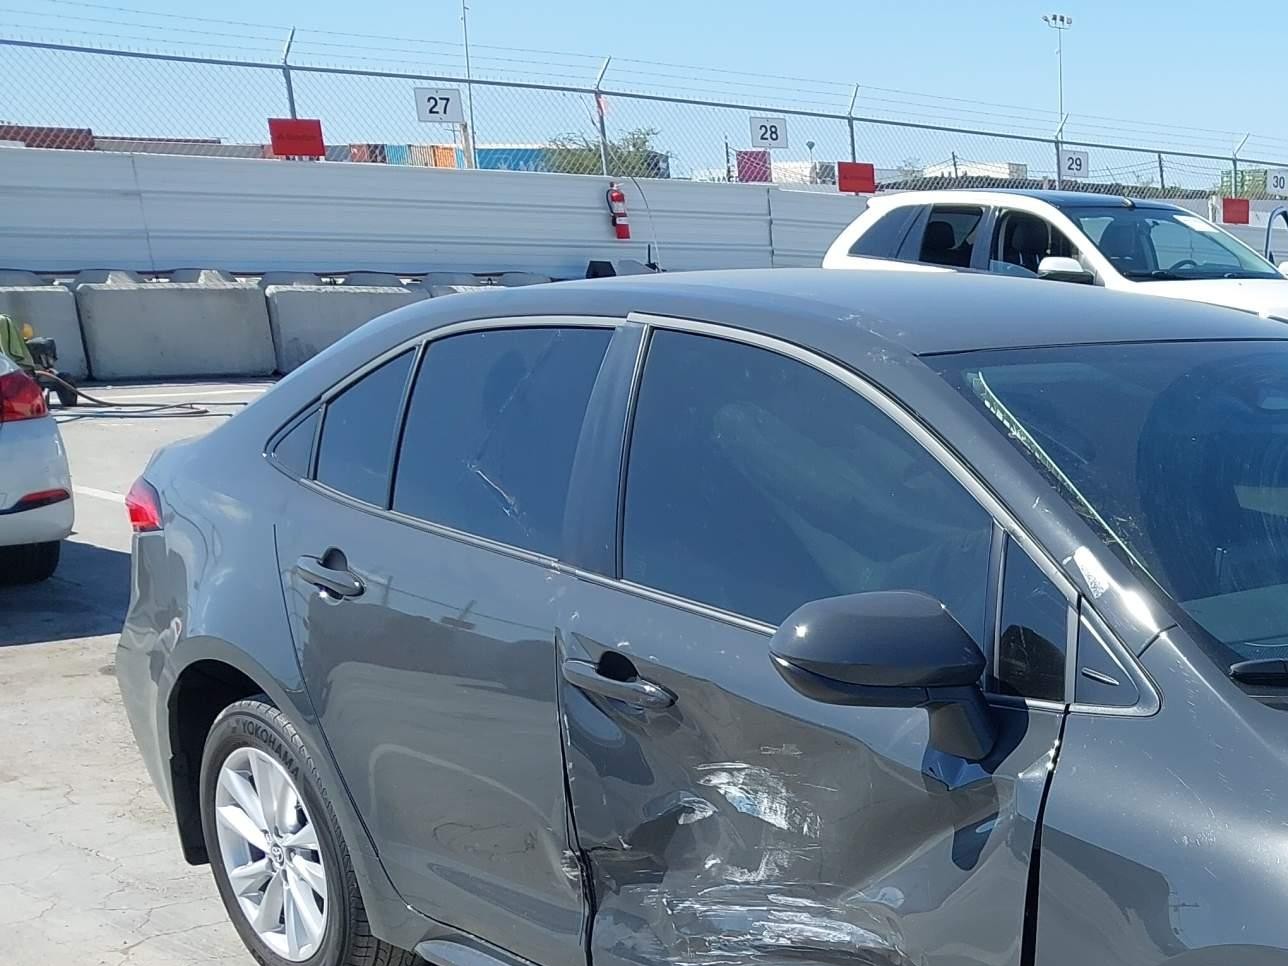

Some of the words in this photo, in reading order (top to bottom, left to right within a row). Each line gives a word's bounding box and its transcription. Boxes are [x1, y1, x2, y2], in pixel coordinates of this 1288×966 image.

[426, 96, 451, 115] 27
[758, 124, 780, 142] 28
[1066, 156, 1082, 171] 29
[1271, 174, 1286, 190] 30
[242, 719, 300, 780] YOKOHAMA
